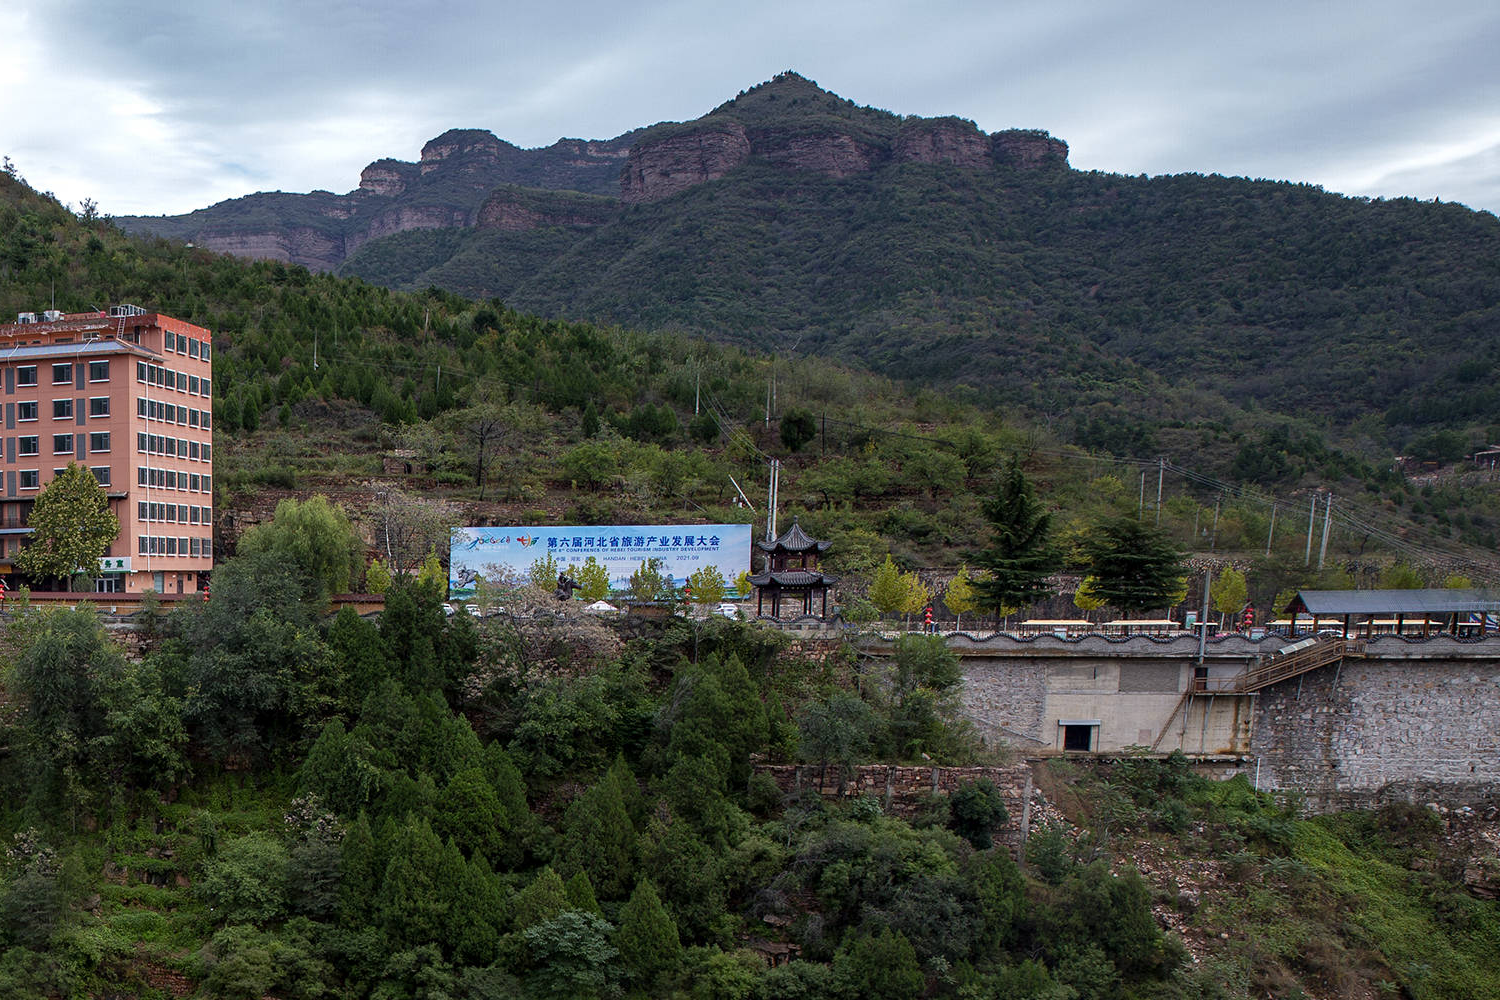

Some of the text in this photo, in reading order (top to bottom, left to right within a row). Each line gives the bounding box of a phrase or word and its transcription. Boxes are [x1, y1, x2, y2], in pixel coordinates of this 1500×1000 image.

[547, 536, 720, 547] 第六届河北省旅游产业发展大会
